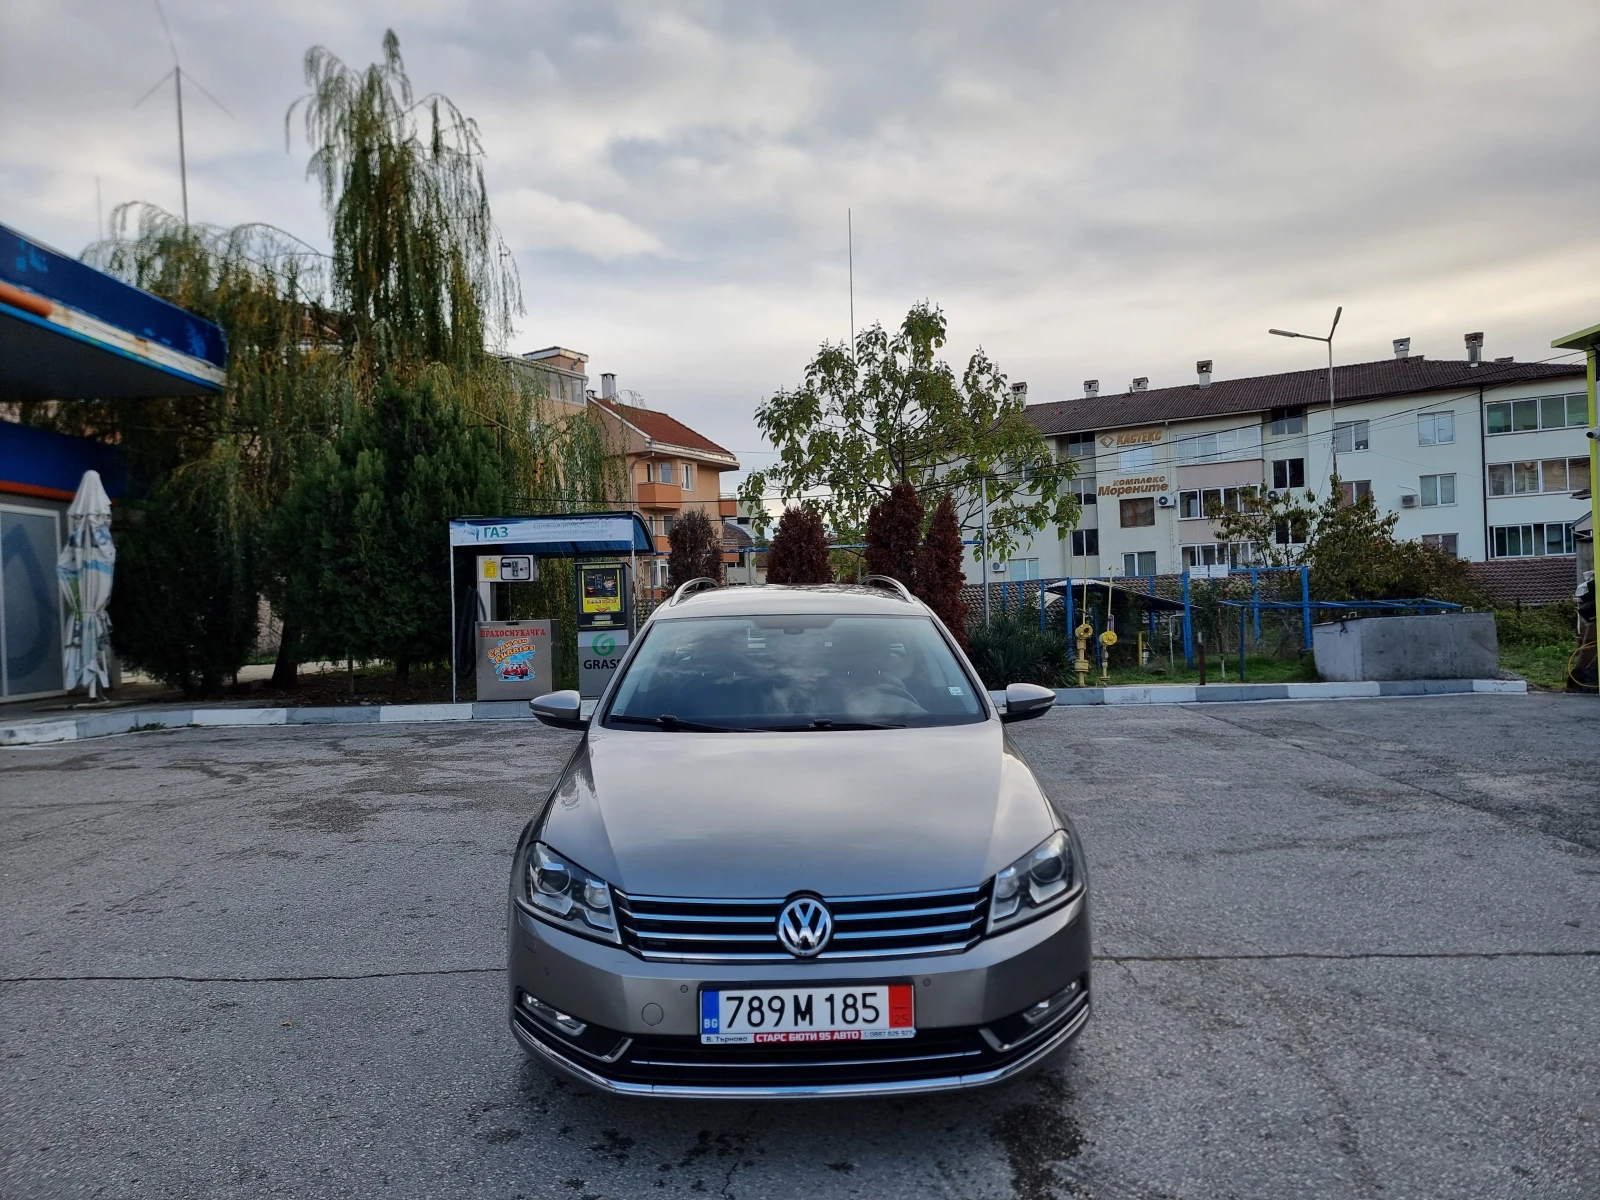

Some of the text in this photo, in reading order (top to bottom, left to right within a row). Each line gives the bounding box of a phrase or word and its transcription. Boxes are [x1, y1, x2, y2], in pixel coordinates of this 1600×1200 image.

[1117, 430, 1163, 445] КАСТЕКС
[1098, 483, 1168, 497] Морените
[483, 526, 509, 539] ГАЗ
[480, 628, 546, 638] ПРАХОСМУКАЧКА
[583, 659, 621, 670] GRAS
[778, 898, 832, 957] VW
[725, 995, 786, 1029] 789
[825, 992, 880, 1026] 185
[703, 1019, 718, 1029] BG
[894, 1014, 909, 1025] 25
[756, 1031, 859, 1042] СТАРС БЮТИ 95 АВТО
